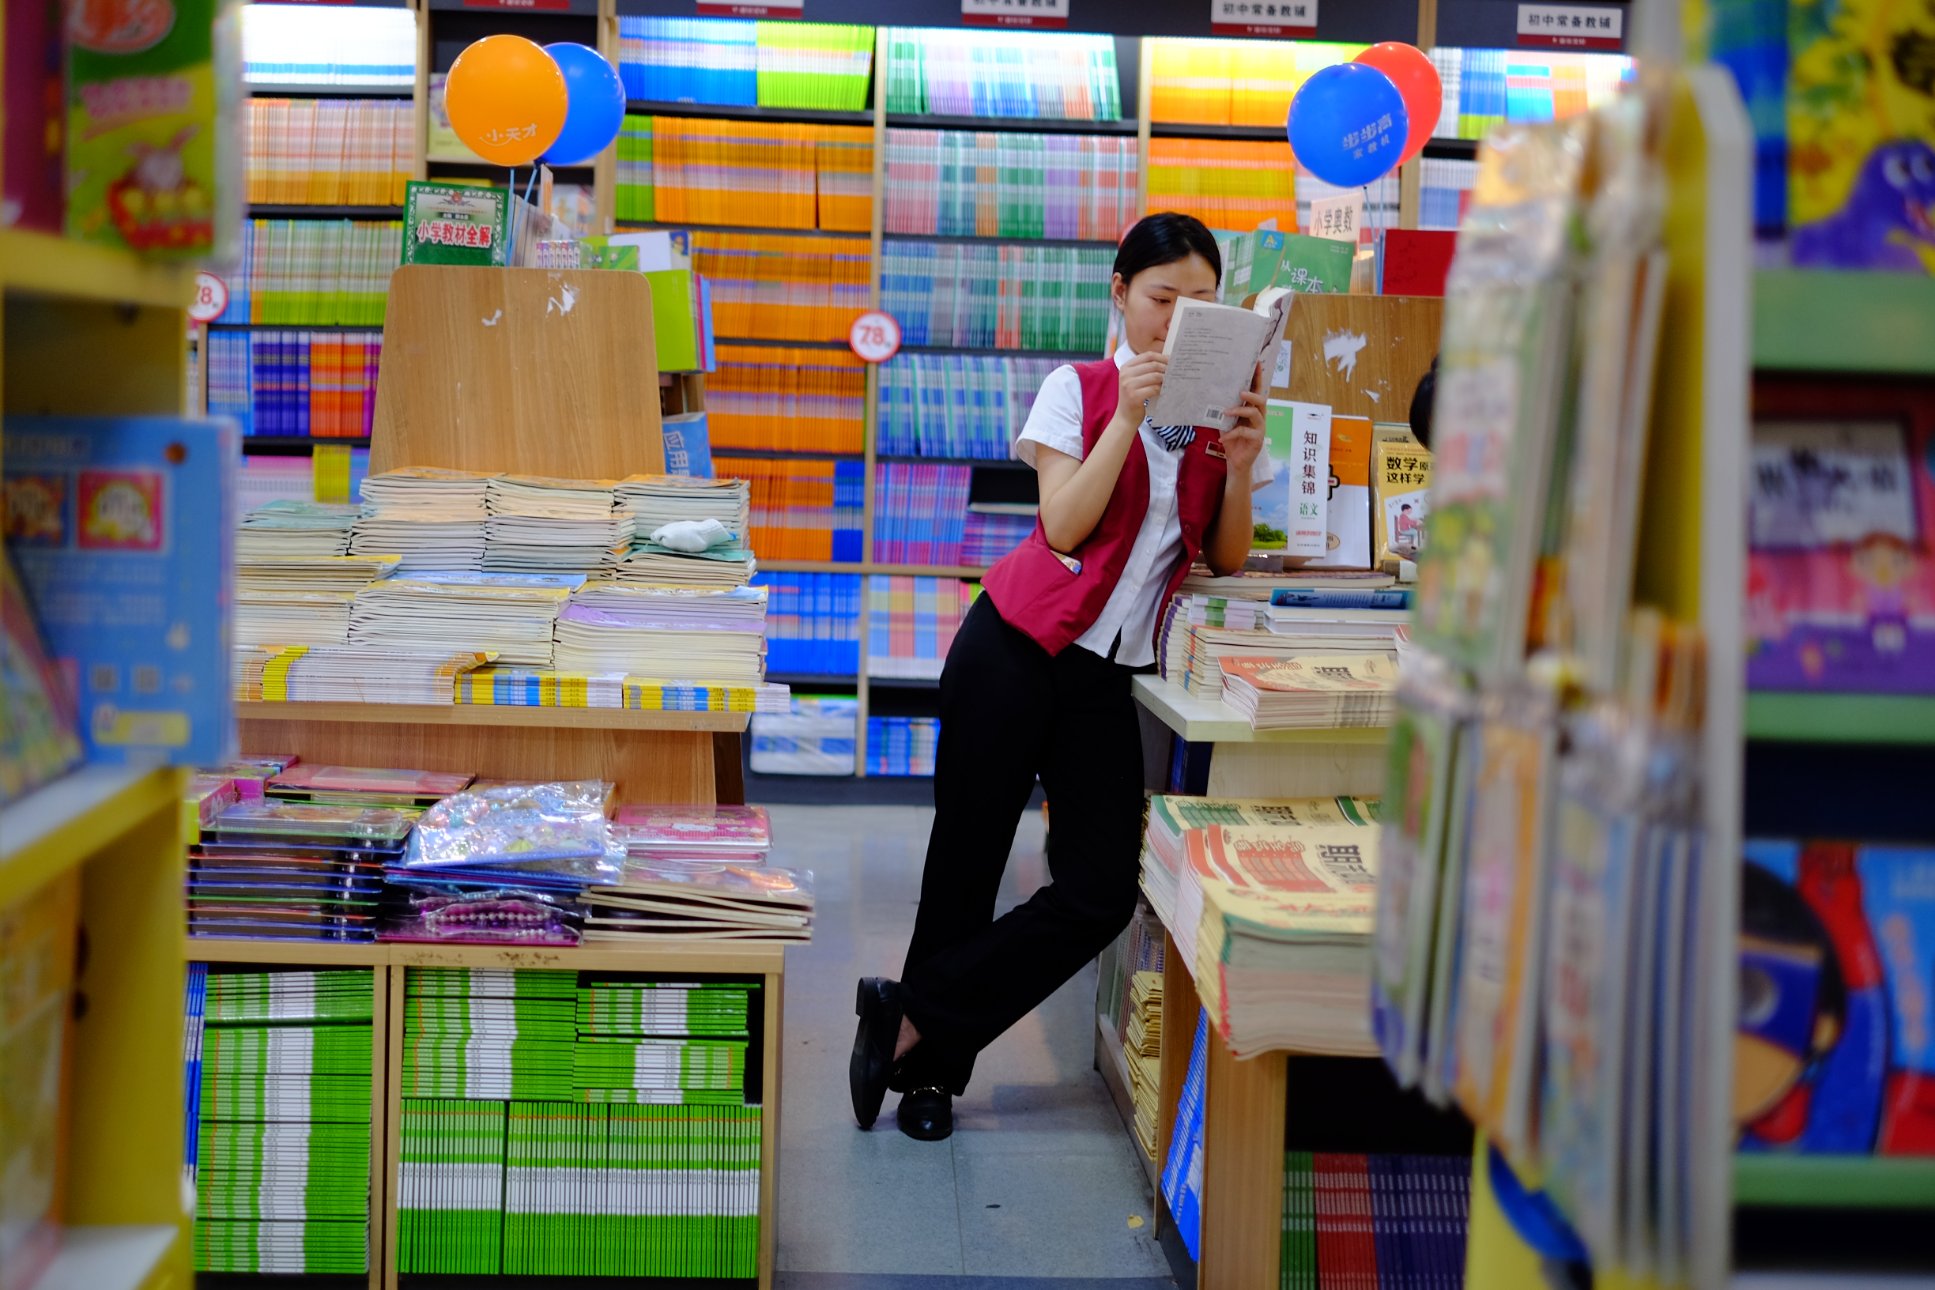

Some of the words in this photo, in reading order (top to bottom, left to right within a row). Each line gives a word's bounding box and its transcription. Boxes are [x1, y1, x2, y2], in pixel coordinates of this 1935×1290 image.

[1529, 14, 1611, 28] 初中常备教辅
[484, 123, 538, 142] 小天才
[1343, 112, 1392, 150] 步步高
[1314, 205, 1353, 237] 小学奥数
[417, 220, 492, 248] 小学教材全解
[859, 325, 885, 346] 78
[1301, 430, 1318, 495] 知识集锦
[1386, 456, 1431, 471] 数学原
[1387, 472, 1425, 485] 这样学
[1299, 502, 1319, 516] 语文
